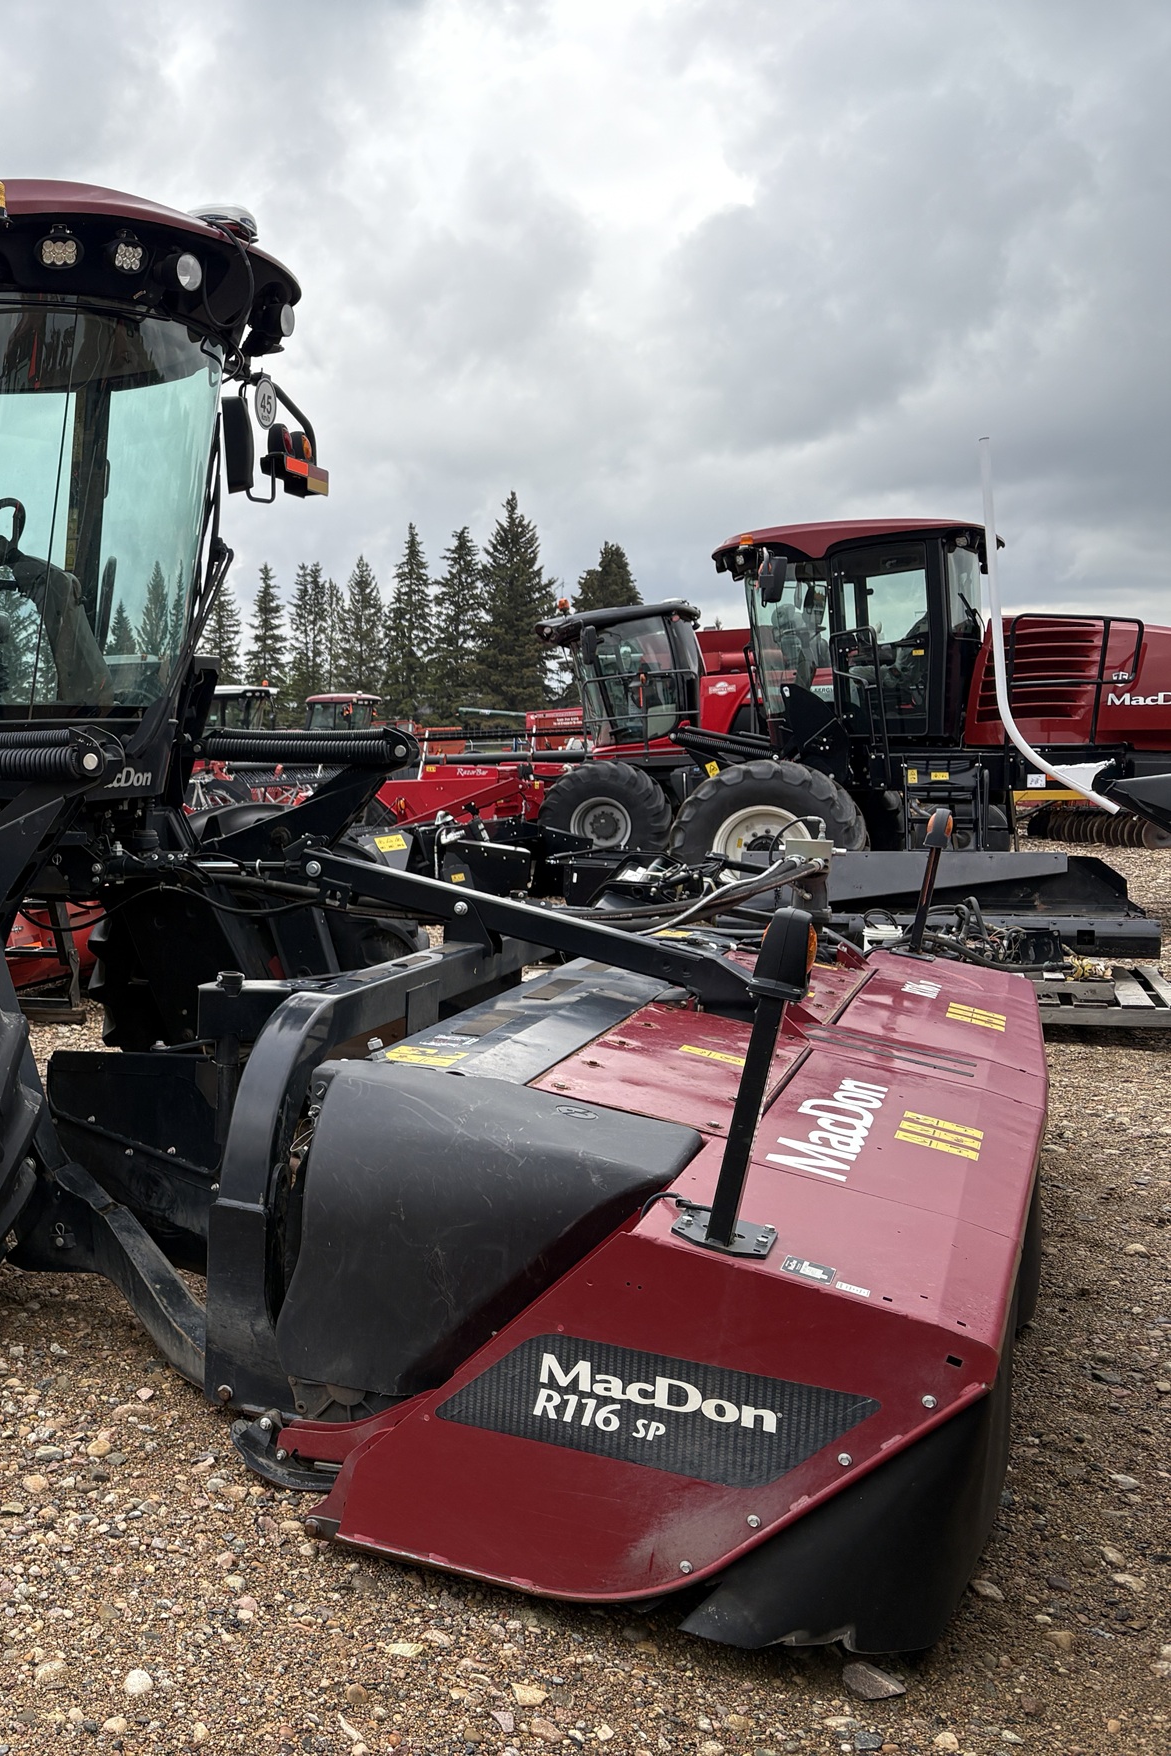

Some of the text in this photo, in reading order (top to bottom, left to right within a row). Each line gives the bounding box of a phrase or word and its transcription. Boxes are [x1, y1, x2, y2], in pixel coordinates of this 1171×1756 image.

[260, 393, 272, 415] 45
[104, 766, 153, 789] cDon
[765, 1076, 889, 1182] MacDon
[532, 1387, 666, 1441] R116 SP
[539, 1352, 778, 1433] MacDon
